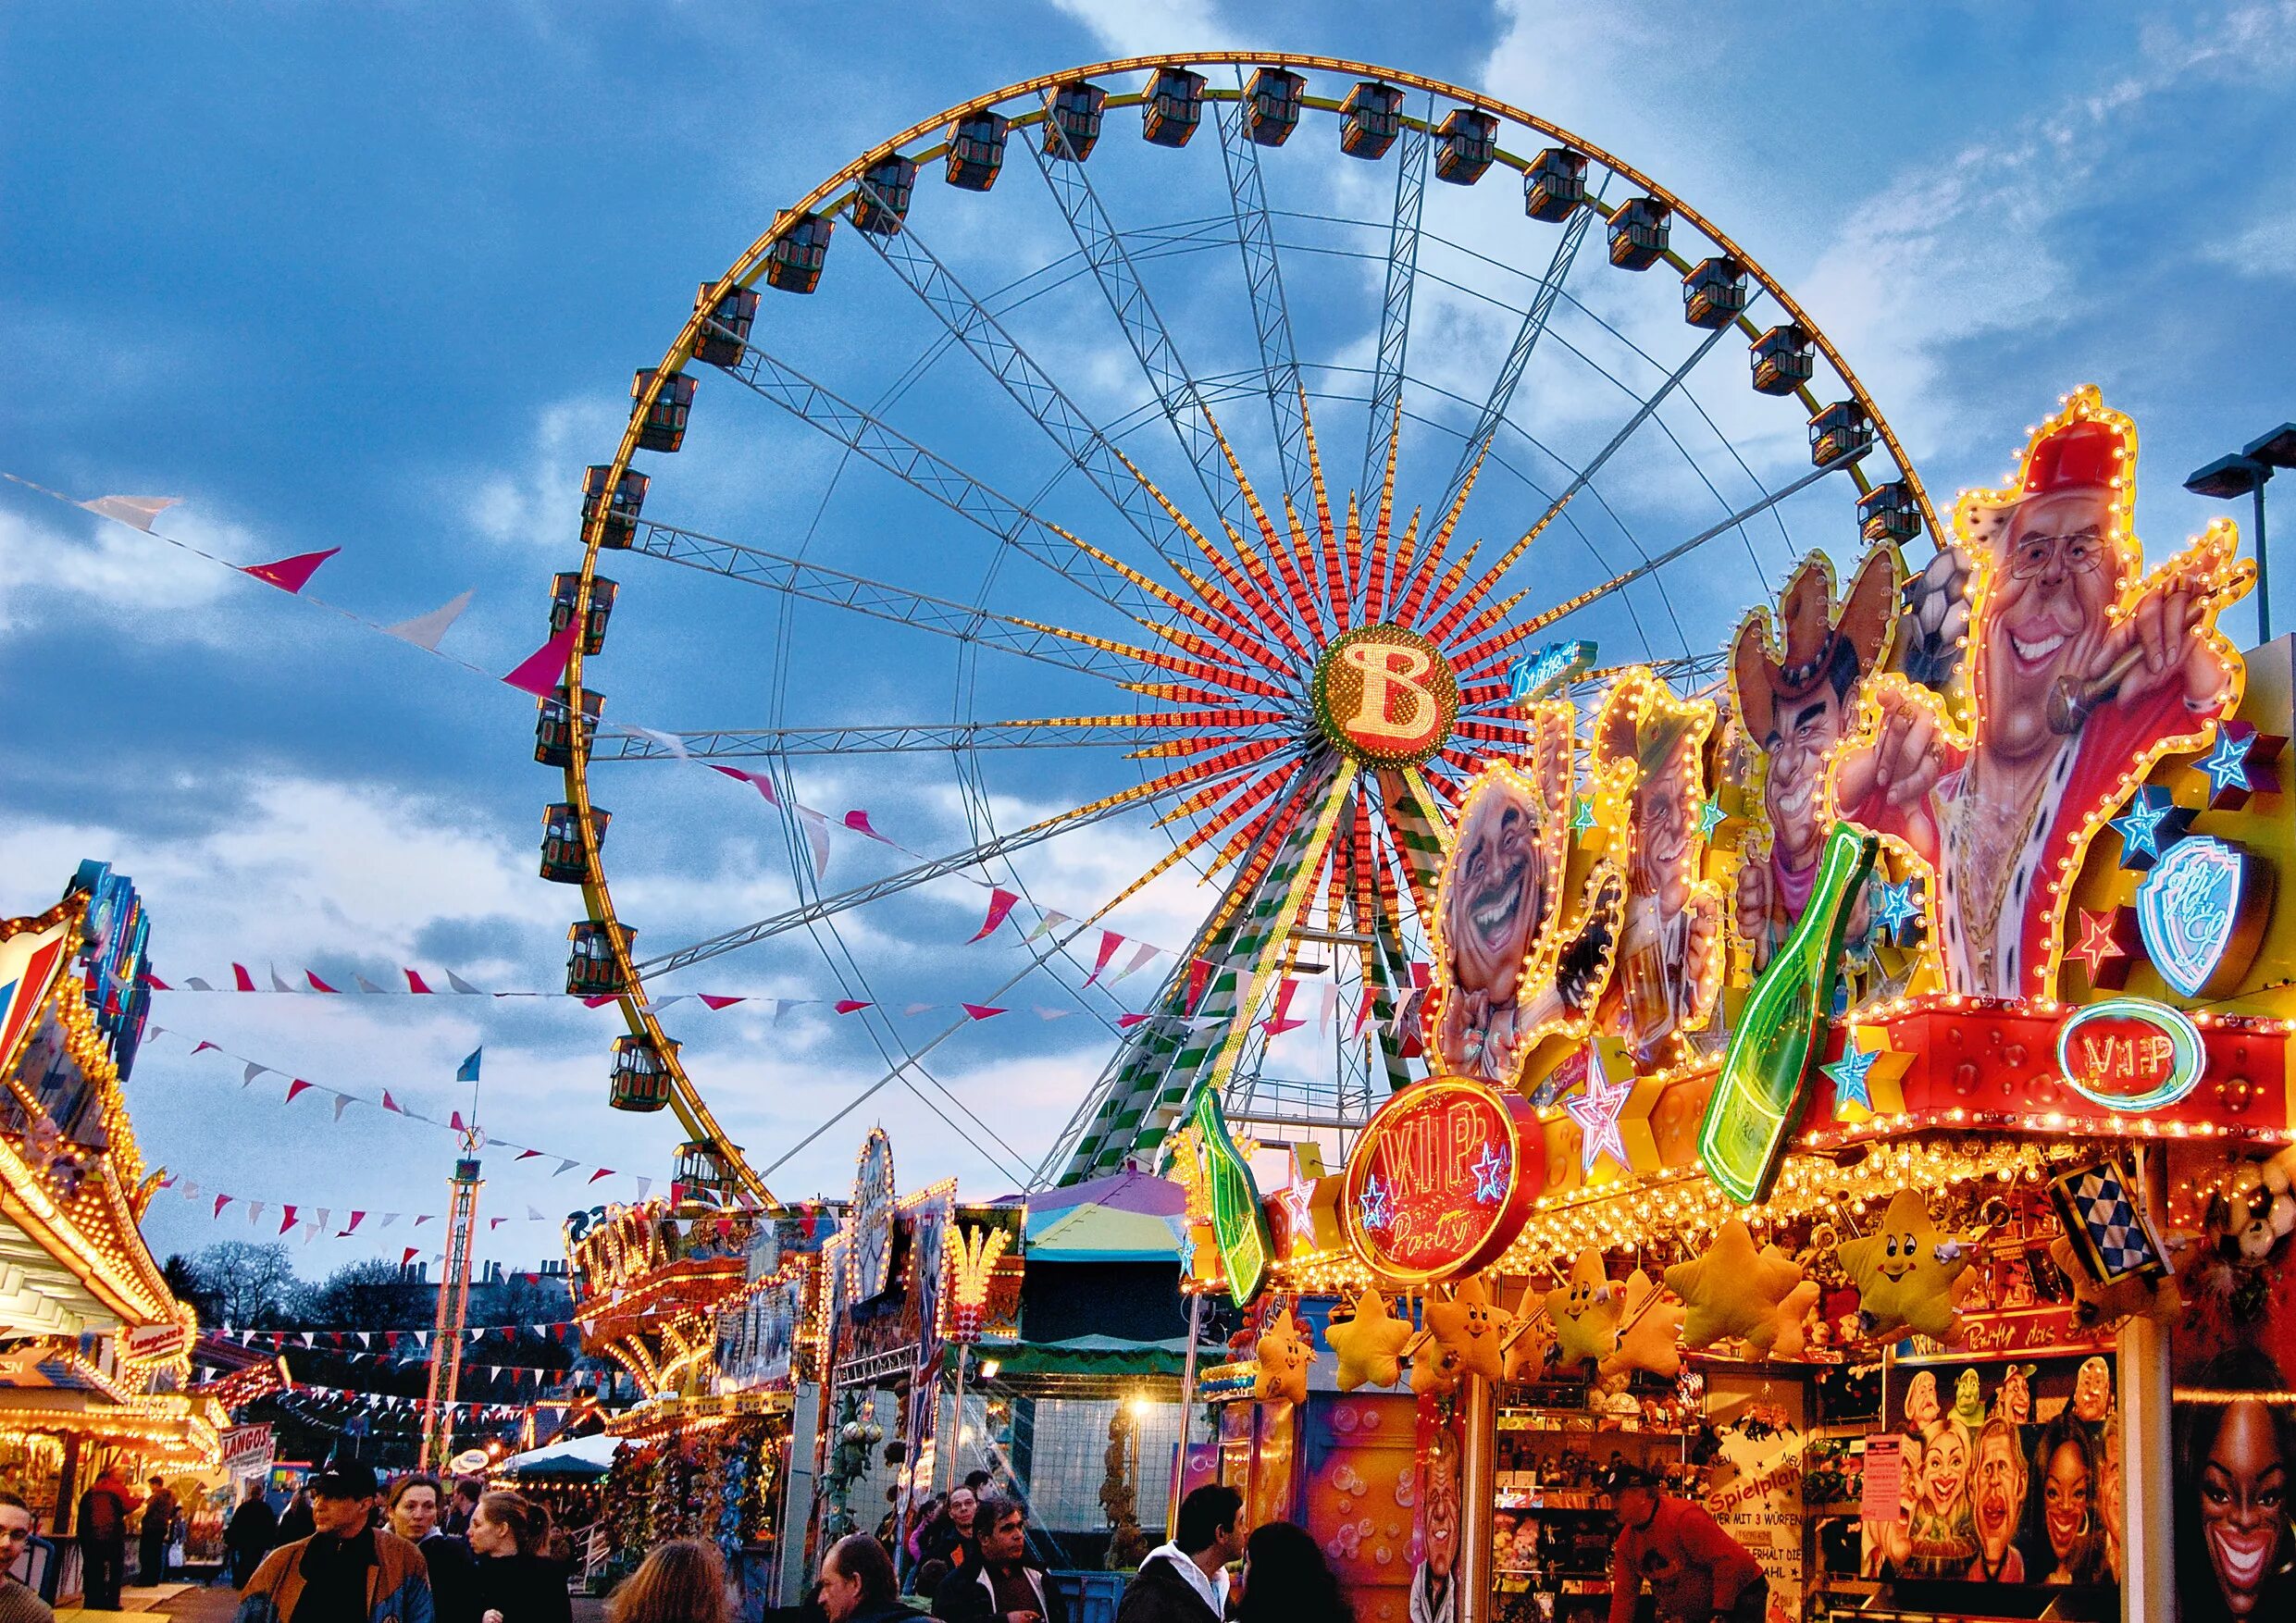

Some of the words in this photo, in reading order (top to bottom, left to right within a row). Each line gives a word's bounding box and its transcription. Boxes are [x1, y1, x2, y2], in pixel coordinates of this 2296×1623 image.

[1345, 642, 1436, 739] B
[2083, 1035, 2174, 1078] VIP
[1379, 1100, 1478, 1206] VIP
[1388, 1208, 1471, 1260] Party
[1964, 1321, 2016, 1352] Party
[224, 1426, 268, 1460] LANGOS
[1711, 1453, 1731, 1468] NEU
[1781, 1452, 1802, 1468] NEU
[1709, 1468, 1801, 1513] Spielplan
[1733, 1514, 1752, 1525] MIT
[1756, 1514, 1760, 1526] 3
[1765, 1511, 1803, 1526] WÜRFEN
[1786, 1549, 1802, 1561] DIE
[1763, 1567, 1786, 1580] AHL
